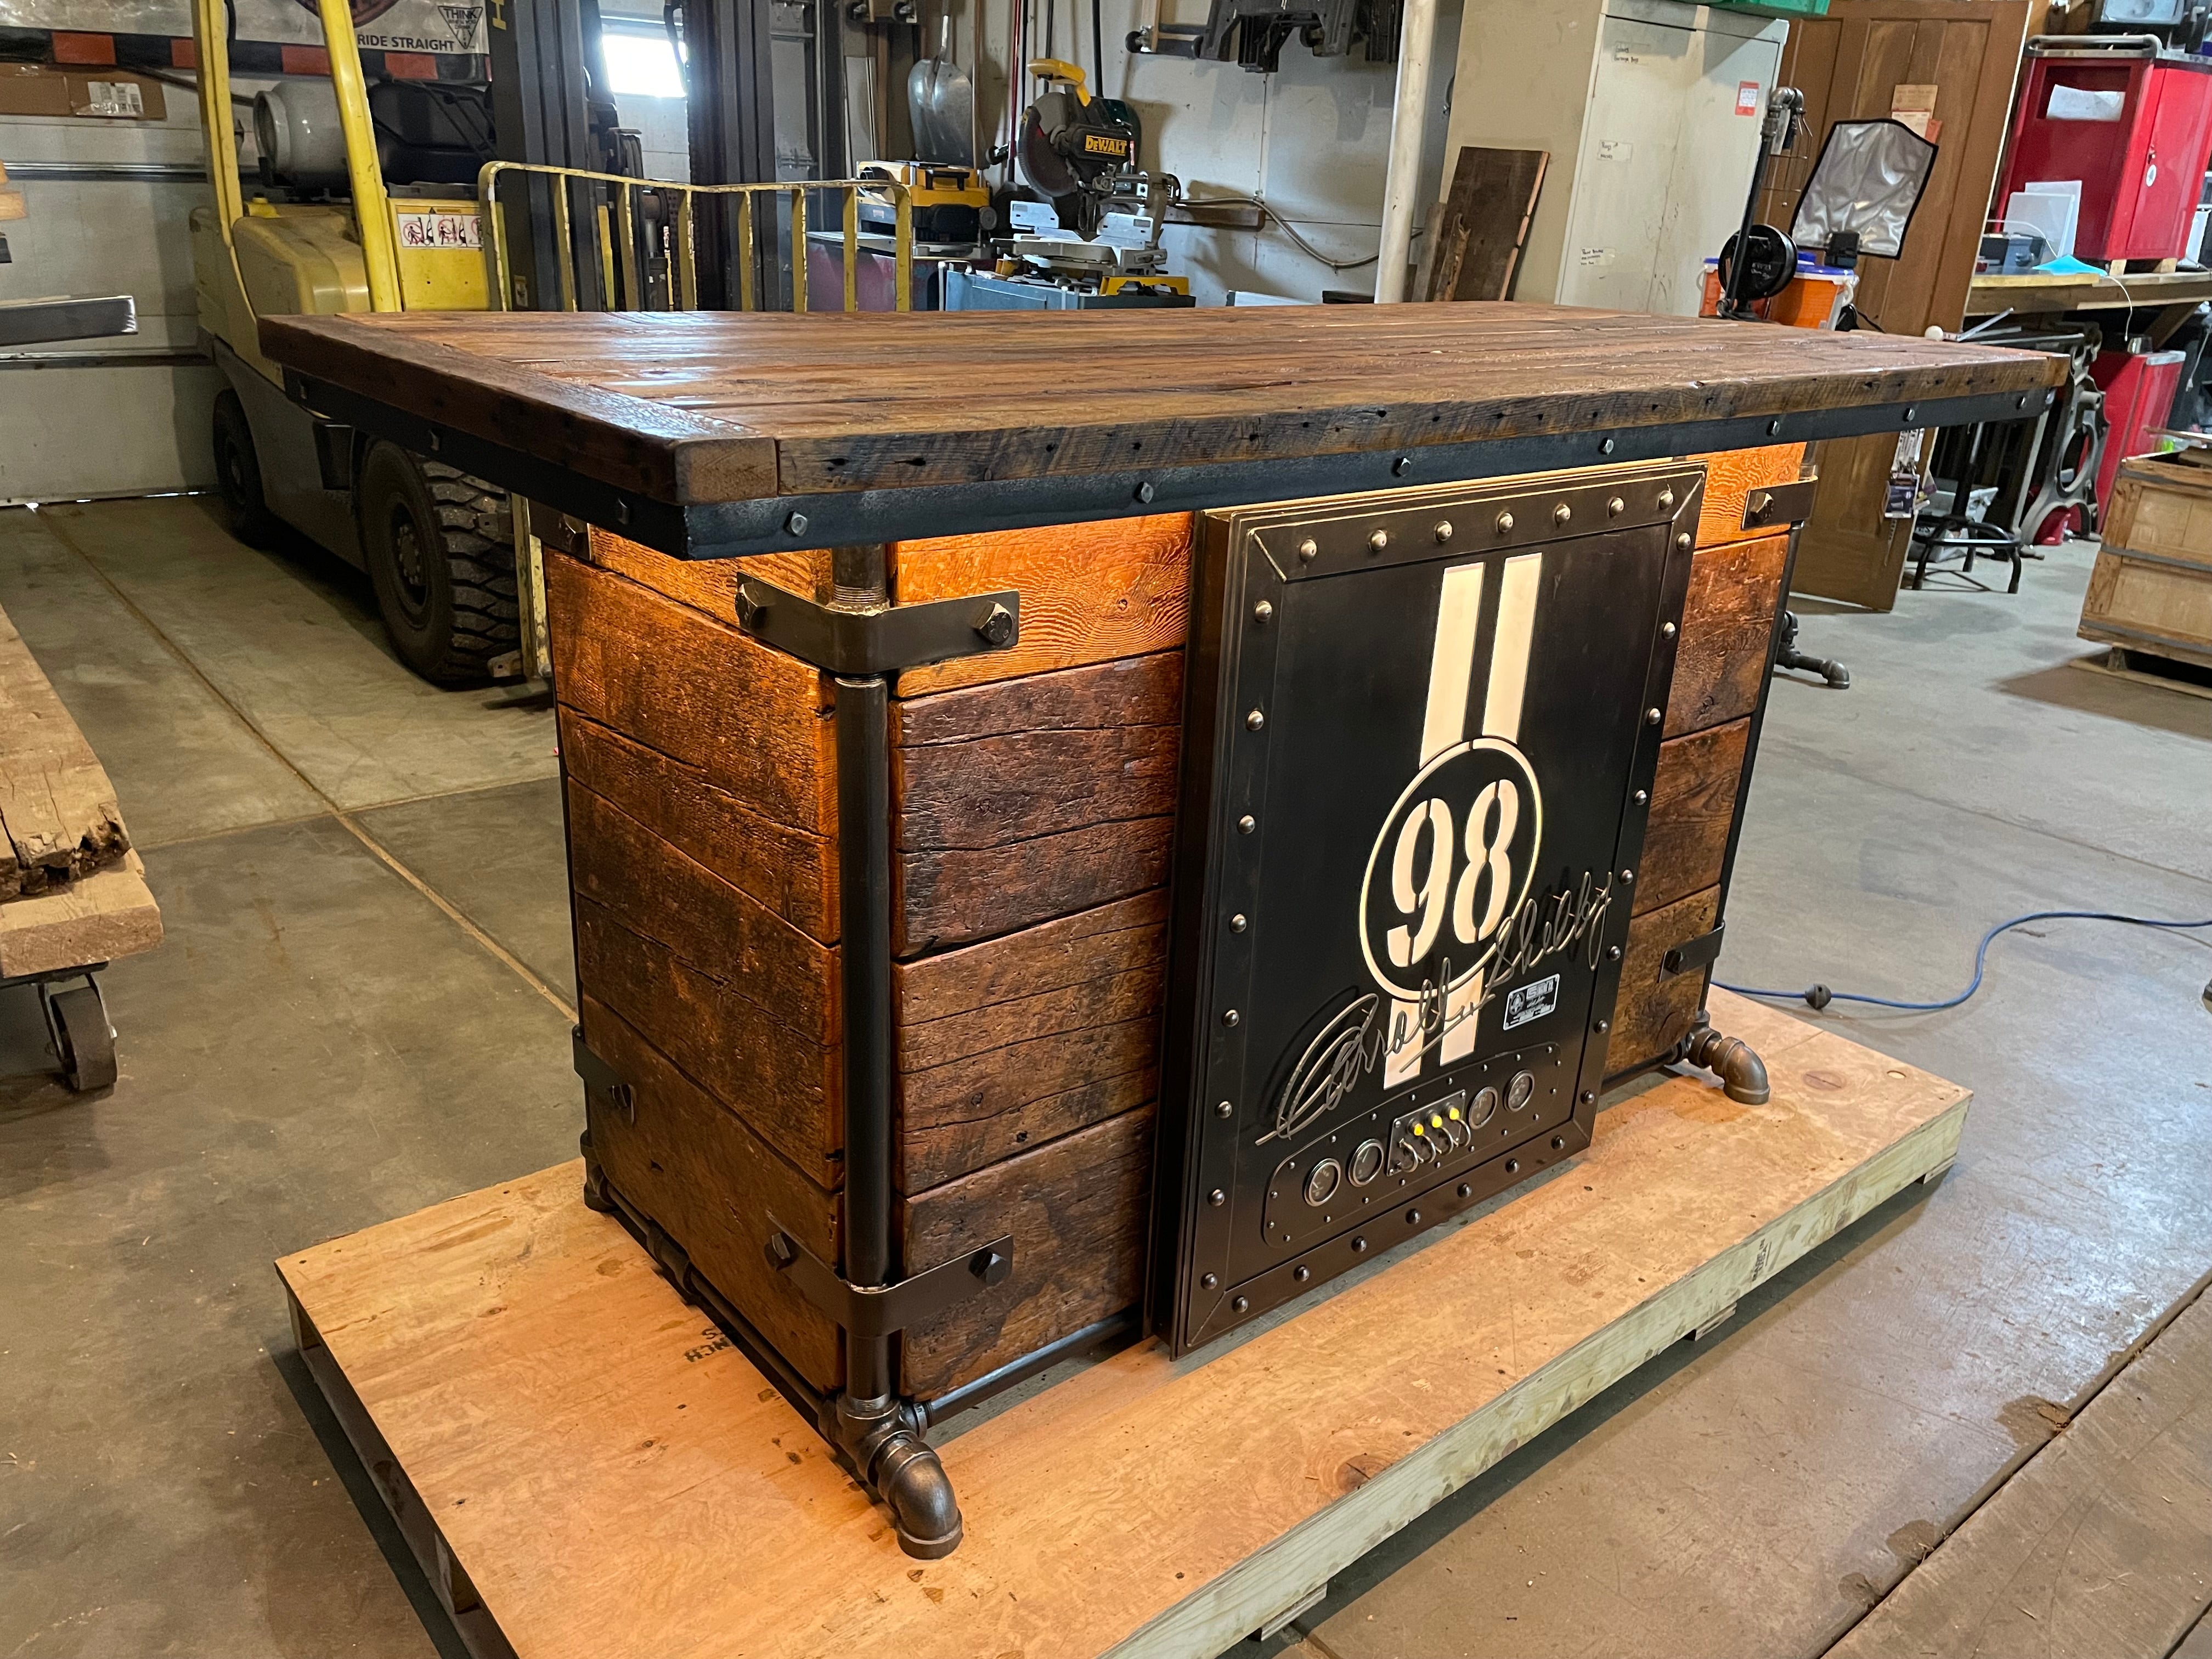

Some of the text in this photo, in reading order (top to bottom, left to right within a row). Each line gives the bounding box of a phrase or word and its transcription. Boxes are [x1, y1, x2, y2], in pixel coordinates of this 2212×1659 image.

[443, 8, 478, 19] THINK
[357, 34, 454, 52] RIDE STRAIGHT
[1387, 779, 1519, 968] 98
